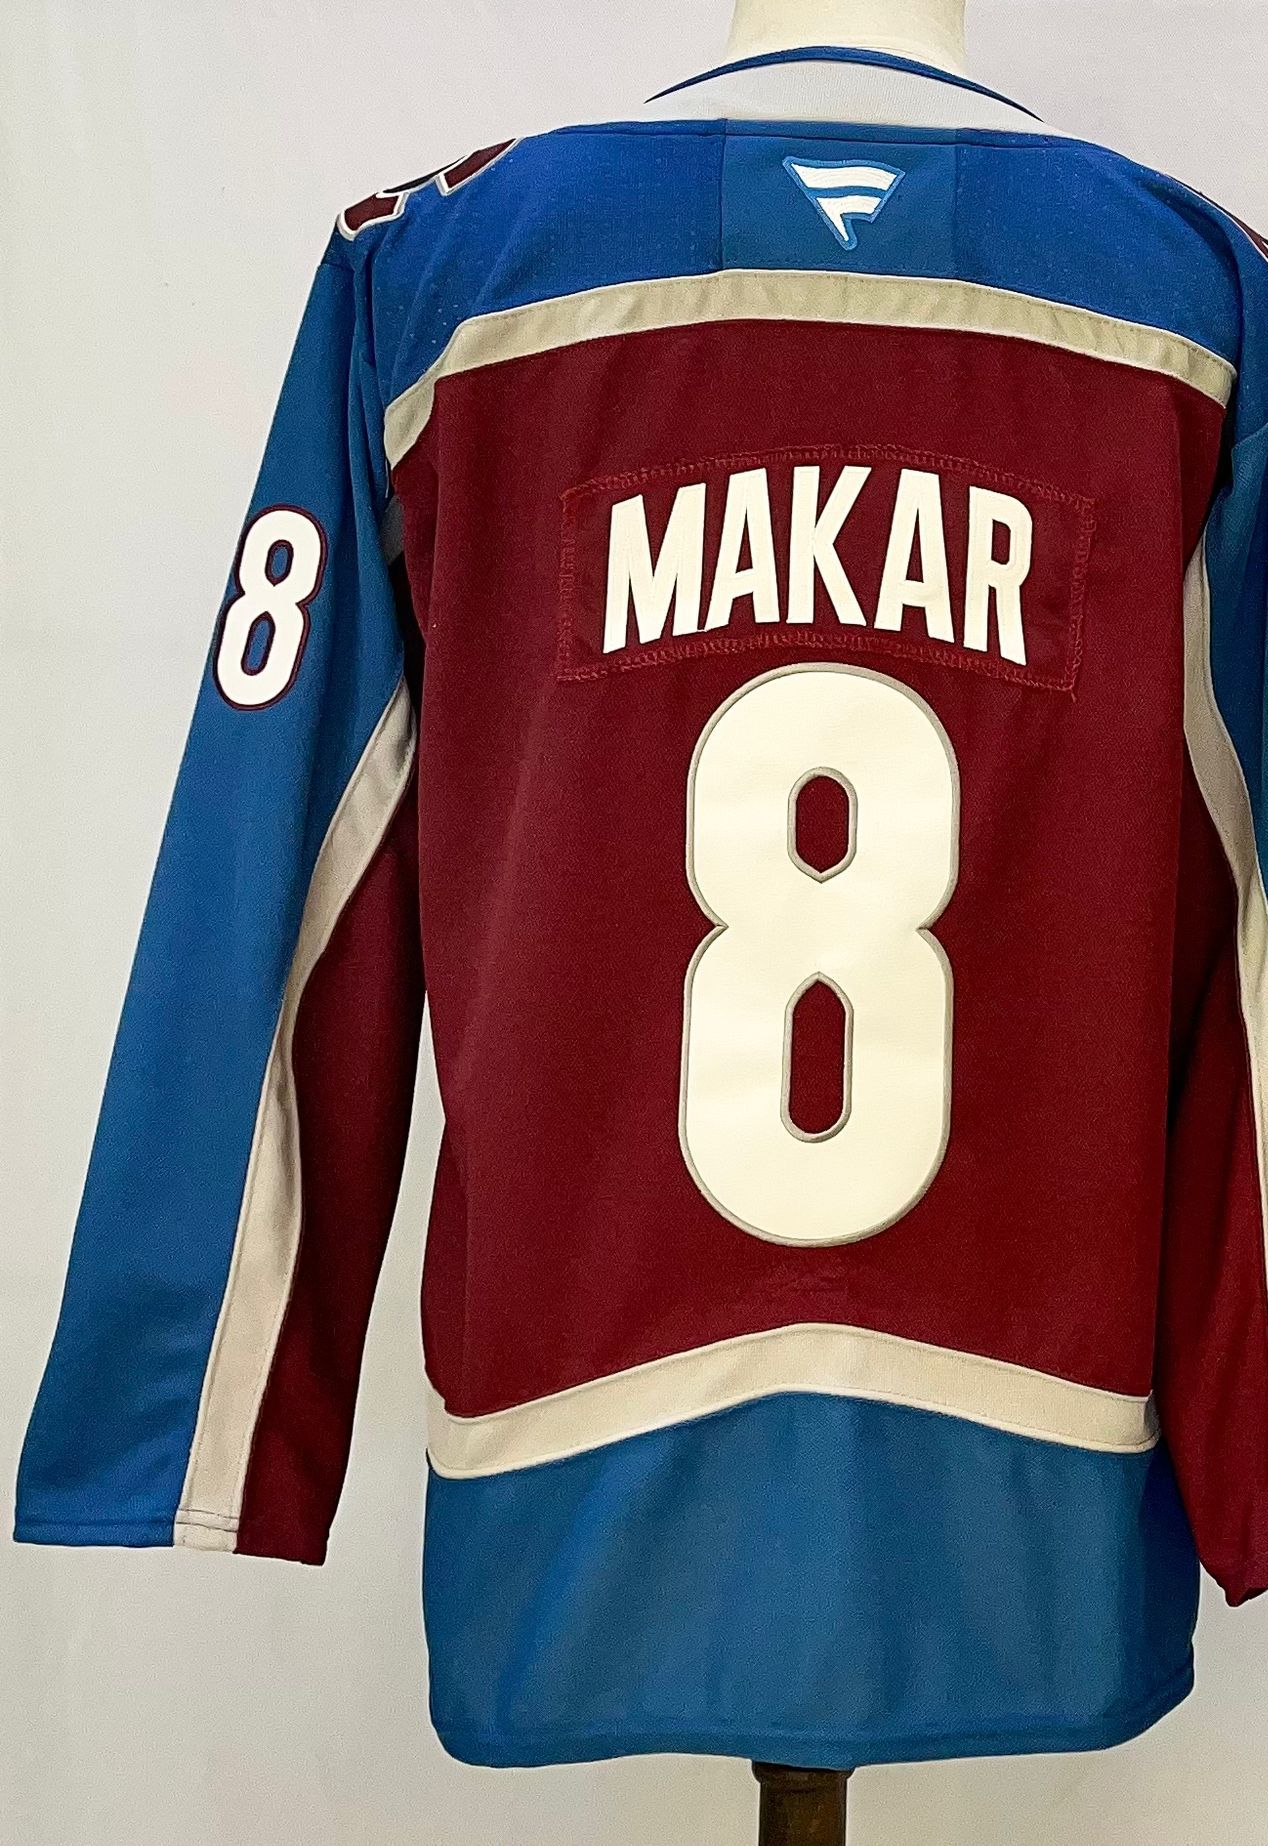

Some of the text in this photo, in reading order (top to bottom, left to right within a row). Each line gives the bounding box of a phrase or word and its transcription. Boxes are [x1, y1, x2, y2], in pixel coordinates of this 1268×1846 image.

[212, 503, 329, 712] 8
[602, 464, 1033, 666] MAKAR
[678, 662, 960, 1247] 8
